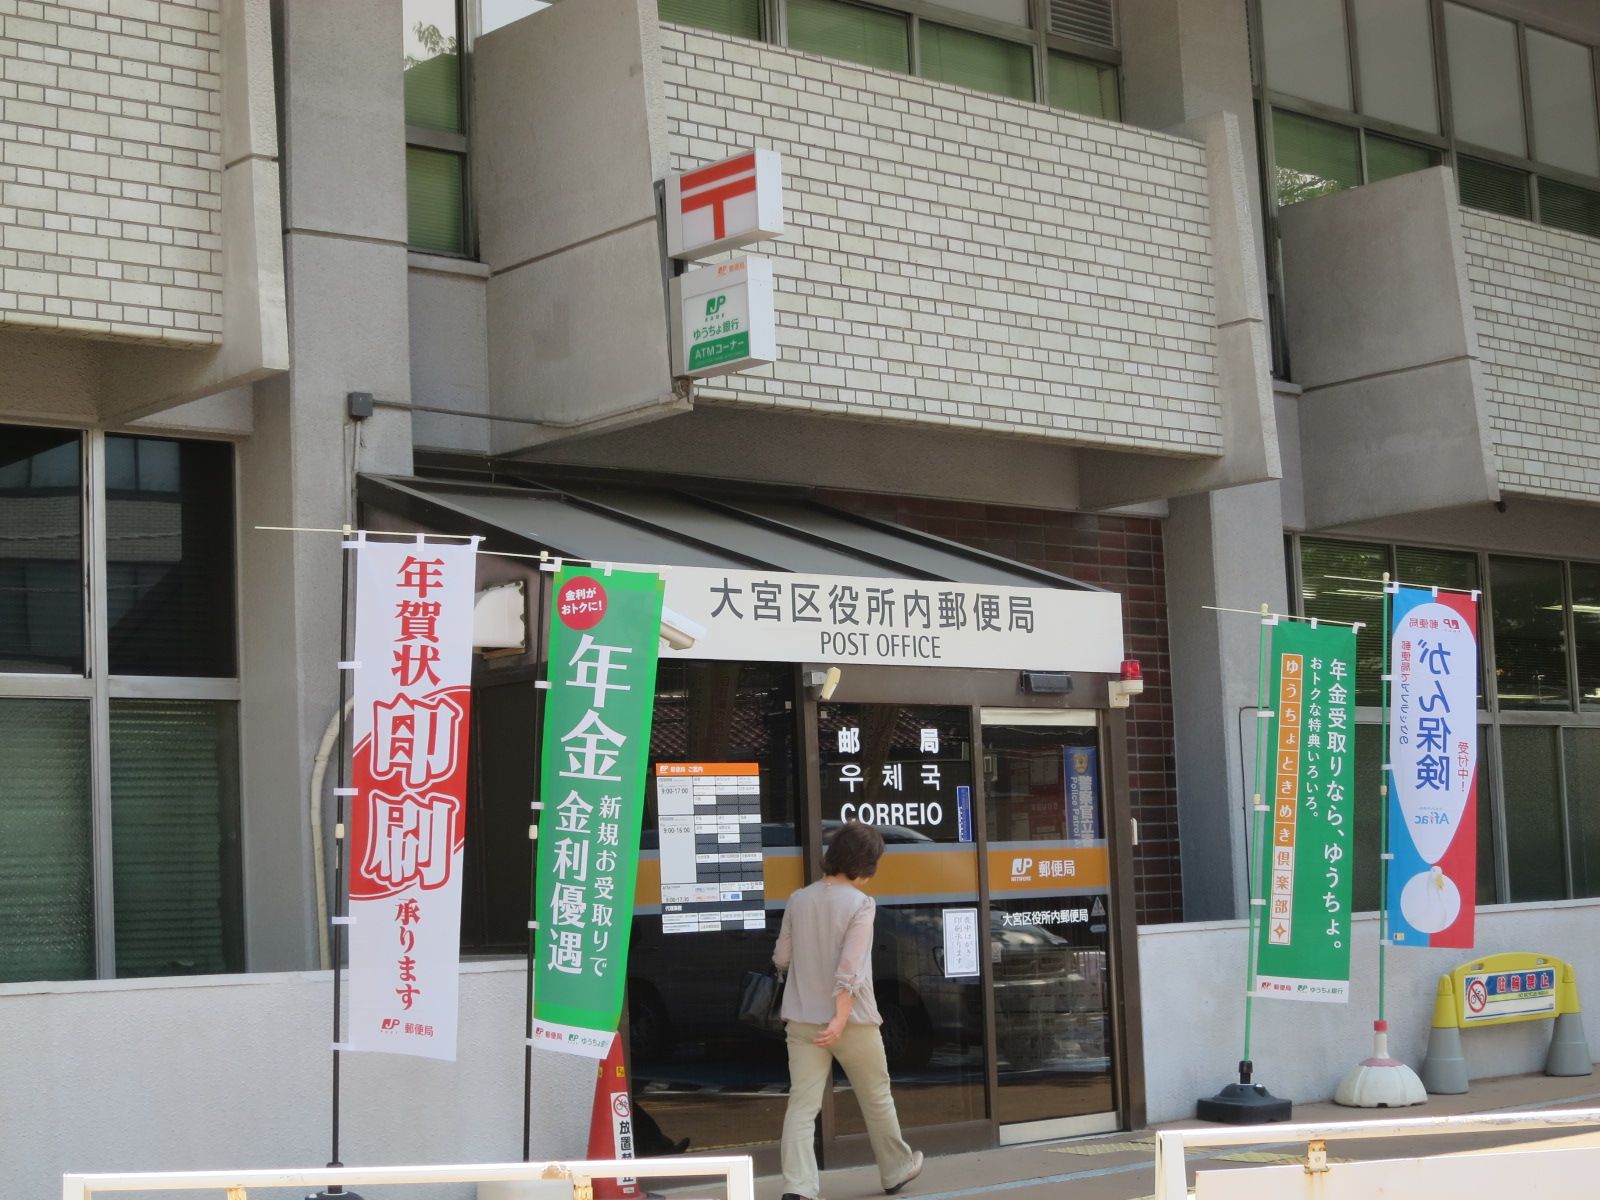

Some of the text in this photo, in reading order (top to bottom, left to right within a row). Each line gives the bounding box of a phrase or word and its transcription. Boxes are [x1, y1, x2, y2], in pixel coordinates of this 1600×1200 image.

[693, 318, 739, 341] ゆうちょ銀行
[695, 340, 744, 361] ATMコーナー
[565, 587, 597, 602] 金利が
[710, 577, 1035, 634] 大宮区役所内郵便局
[391, 555, 445, 687] 年賀状
[820, 631, 942, 659] POST OFFICE
[559, 633, 633, 782] 年金
[1305, 657, 1323, 818] おトクな特典いろいろ。
[365, 695, 461, 890] 印刷
[1070, 777, 1079, 806] Police
[1274, 659, 1299, 914] ゆうちょときめき倶楽部
[1323, 658, 1348, 949] 年金受取りなら、ゆうちょ。
[840, 802, 943, 826] CORREIO
[1072, 807, 1081, 837] Patrol
[548, 790, 594, 975] 金利優遇
[589, 795, 622, 977] 新規お受取りで
[1038, 860, 1076, 877] 郵便局
[1002, 908, 1089, 927] 大宮区役所内郵便局
[395, 897, 421, 1011] 承ります
[404, 1022, 434, 1037] 郵便局
